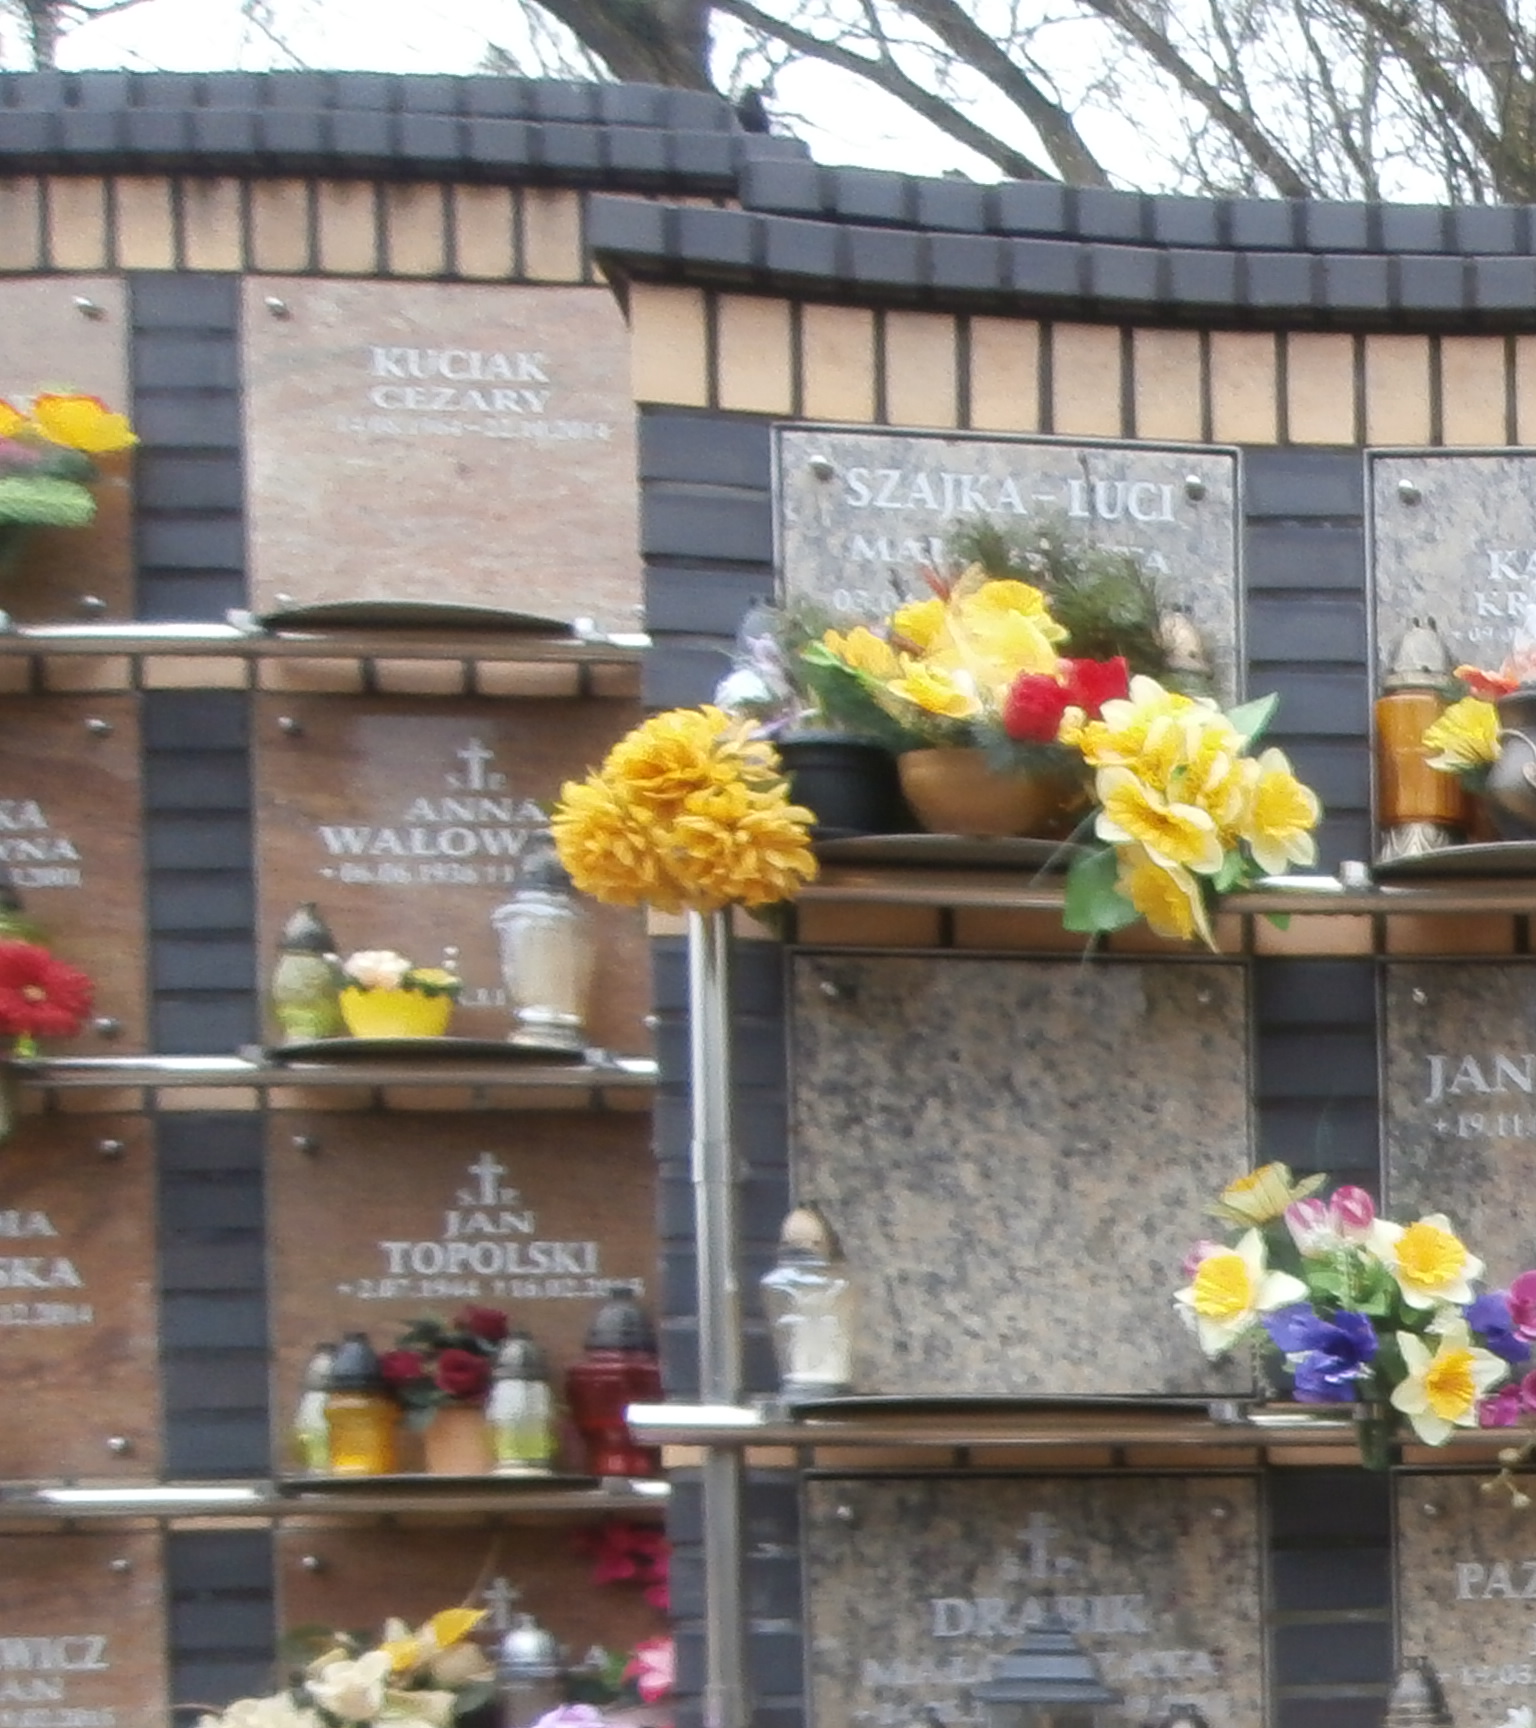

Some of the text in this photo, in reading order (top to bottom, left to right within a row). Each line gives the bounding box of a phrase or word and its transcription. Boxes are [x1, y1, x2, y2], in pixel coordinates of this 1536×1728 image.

[367, 346, 550, 383] KUCIAK
[367, 385, 550, 414] CEZARY
[846, 467, 1027, 518] SZAJKA
[403, 797, 549, 822] ANNA
[443, 1209, 537, 1239] JAN
[377, 1240, 599, 1275] TOPOLSKI
